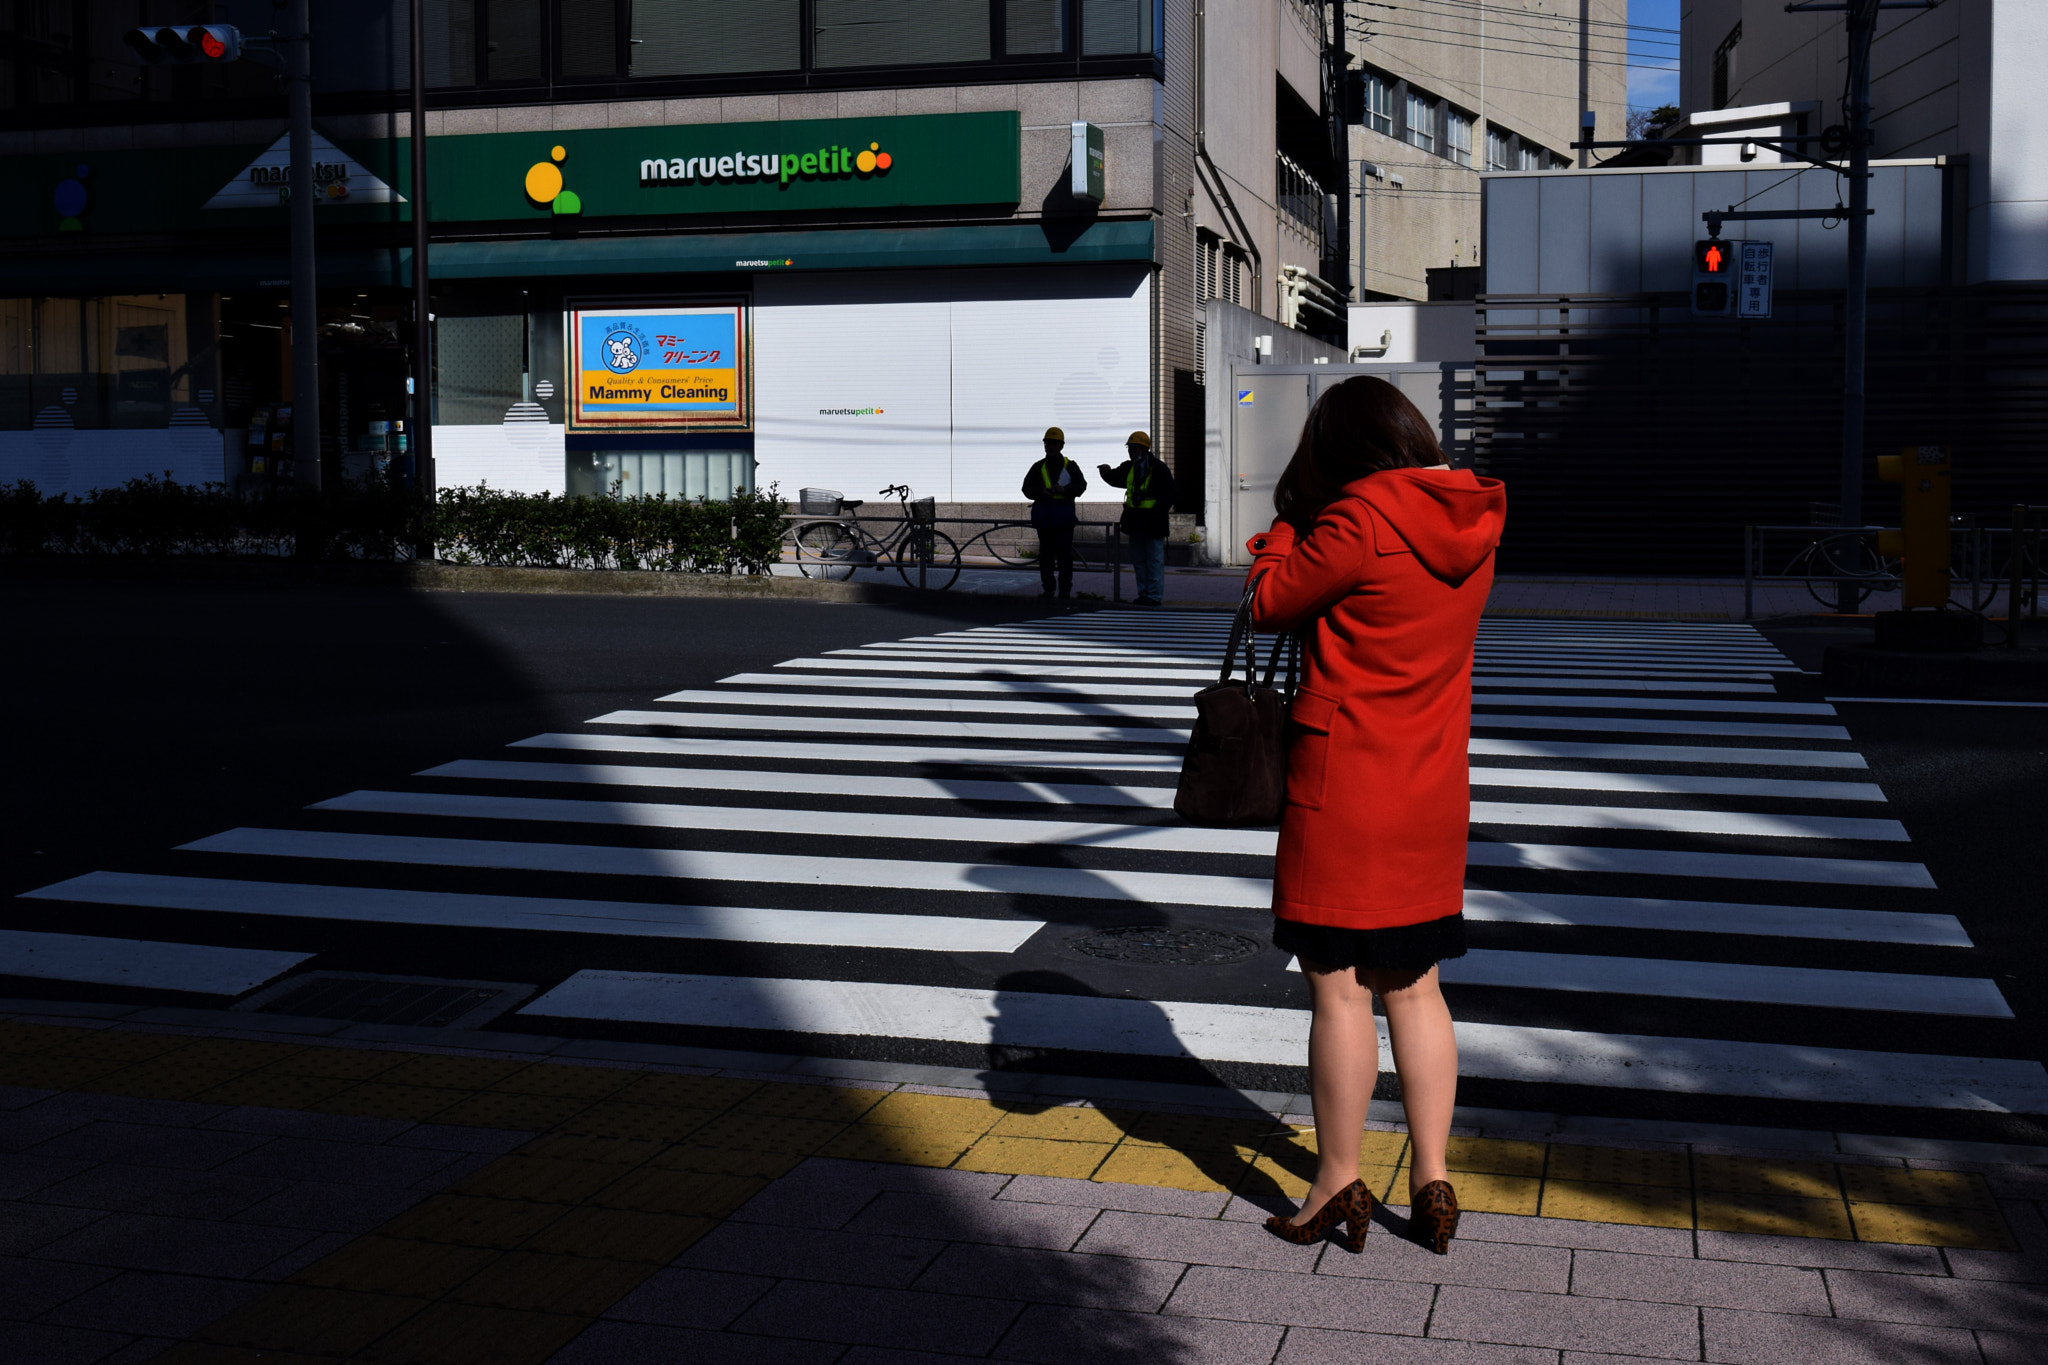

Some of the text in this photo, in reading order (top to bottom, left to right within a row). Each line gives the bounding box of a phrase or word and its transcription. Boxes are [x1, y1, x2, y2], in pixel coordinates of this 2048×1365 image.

[250, 162, 346, 182] martsu
[655, 335, 685, 347] マミー
[663, 350, 721, 364] クリーニング
[606, 376, 635, 386] Quality
[693, 375, 714, 384] Price
[589, 384, 728, 402] Mammy Cleaning
